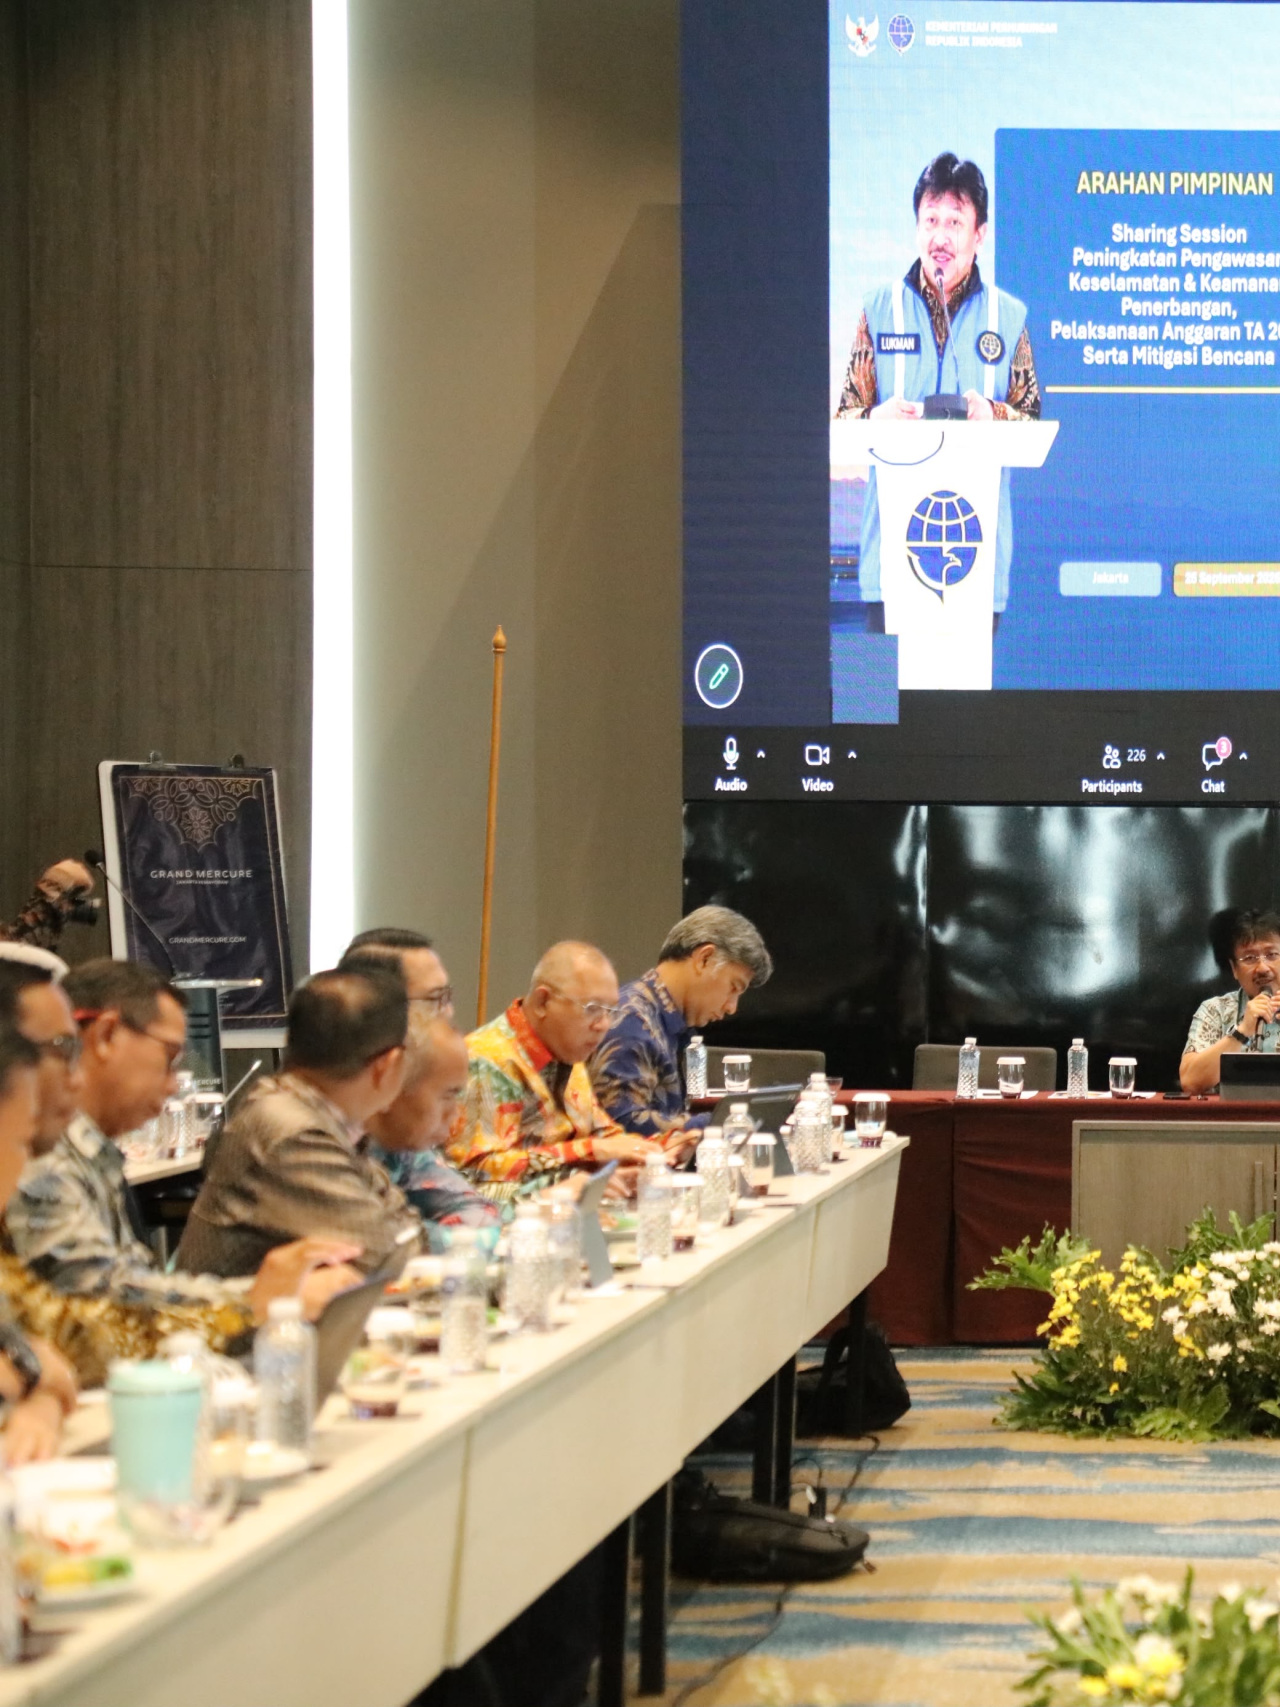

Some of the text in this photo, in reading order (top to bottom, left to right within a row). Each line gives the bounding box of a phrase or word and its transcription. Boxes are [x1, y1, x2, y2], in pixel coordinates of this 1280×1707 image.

[1076, 171, 1274, 195] ARAHAN PIMPINAN
[1112, 223, 1247, 246] Sharing Session
[1073, 247, 1177, 271] Peningkatan
[1069, 272, 1179, 292] Keselamatan
[1184, 273, 1197, 292] &
[1121, 297, 1237, 321] Penerbangan,
[1050, 321, 1159, 340] Pelaksanaan
[1162, 322, 1241, 345] Anggaran
[1244, 321, 1265, 341] TA
[881, 337, 915, 350] LUKMAN
[1083, 346, 1275, 370] Serta Mitigasi Bencana
[1092, 571, 1129, 584] Jakarta
[1198, 571, 1255, 587] September
[1220, 741, 1228, 753] 3
[1127, 749, 1146, 763] 226
[715, 778, 747, 791] Audio
[802, 778, 834, 792] Video
[1081, 780, 1143, 796] Participants
[1201, 780, 1226, 793] Chat
[150, 869, 252, 880] GRAND MERCURE
[169, 936, 246, 944] GRANDMERCURE.COM
